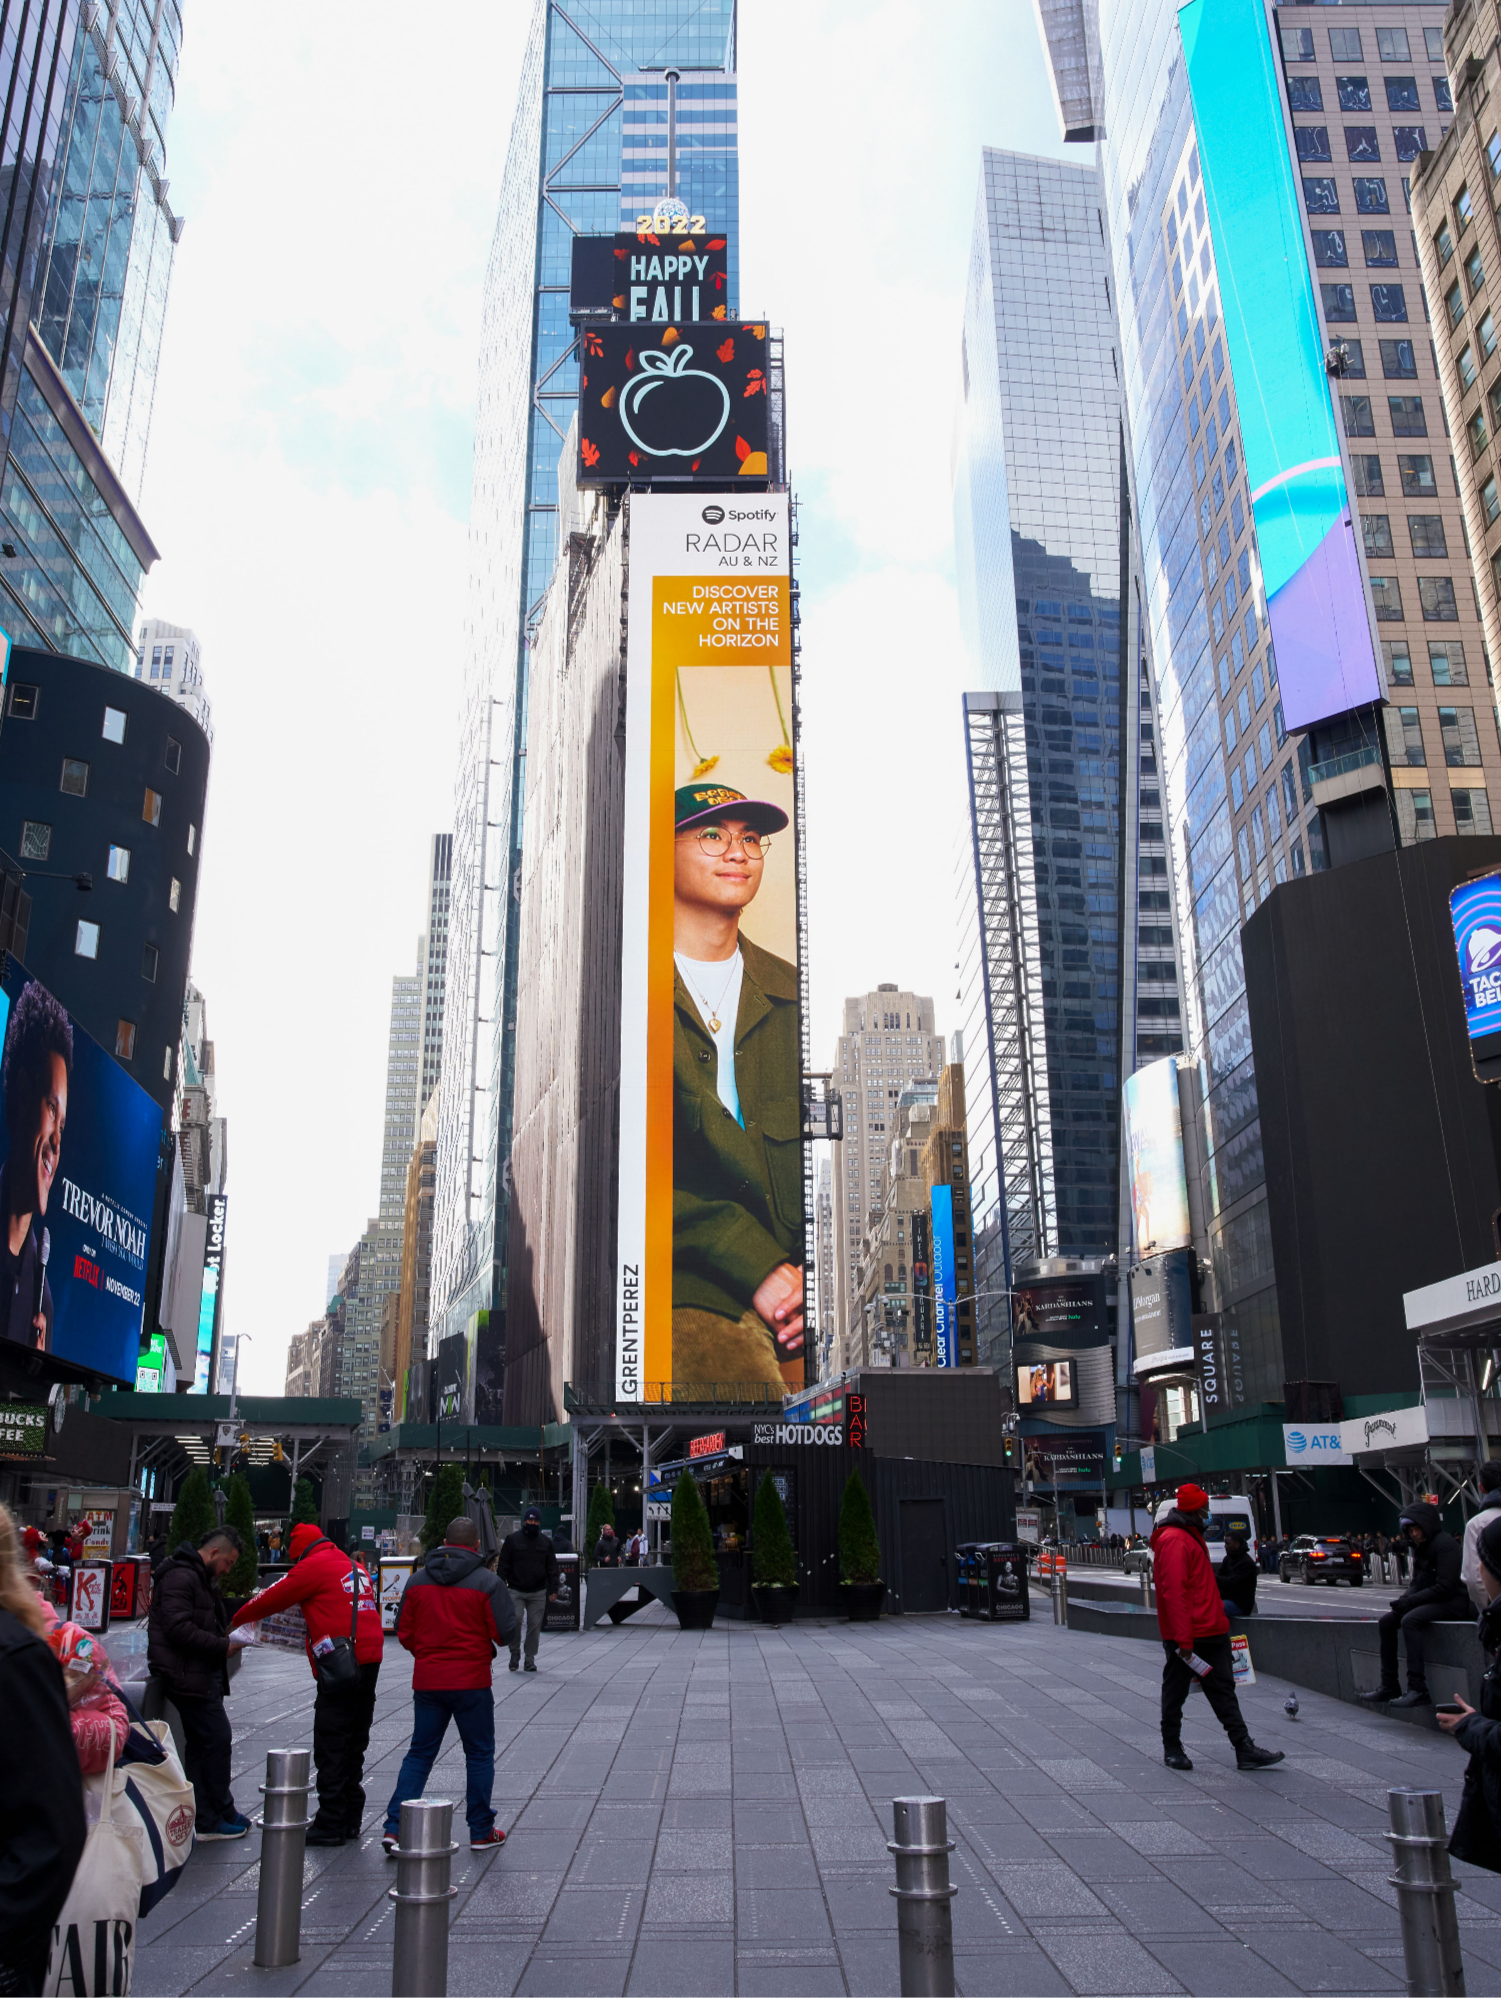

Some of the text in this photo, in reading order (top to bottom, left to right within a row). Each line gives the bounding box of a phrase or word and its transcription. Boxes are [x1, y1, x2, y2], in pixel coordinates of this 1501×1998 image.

[636, 215, 706, 234] 2022
[630, 255, 709, 281] HAPPY
[728, 510, 776, 522] Spotify
[686, 533, 778, 552] RADAR
[718, 556, 778, 566] AU & NZ
[692, 586, 778, 598] DISCOVER
[663, 602, 779, 614] NEW ARTISTS
[713, 618, 779, 630] ON THE
[699, 634, 779, 647] HORIZON
[62, 1176, 146, 1260] TREVOR NOAH
[73, 1254, 100, 1289] NETFLIX
[106, 1276, 140, 1307] NOVEMBER 22
[1466, 1272, 1501, 1301] HARD
[933, 1236, 946, 1368] Clear Channel Outdoor
[1035, 1300, 1093, 1311] KARDASHIANS
[622, 1264, 639, 1394] GRENTPEREZ
[1200, 1328, 1218, 1403] SQUARE
[754, 1424, 774, 1434] NYC's
[849, 1396, 863, 1448] BAR
[754, 1433, 774, 1444] best
[1311, 1435, 1342, 1449] AT&
[1044, 1453, 1104, 1461] KARDASHIANS
[87, 1511, 112, 1521] ATM
